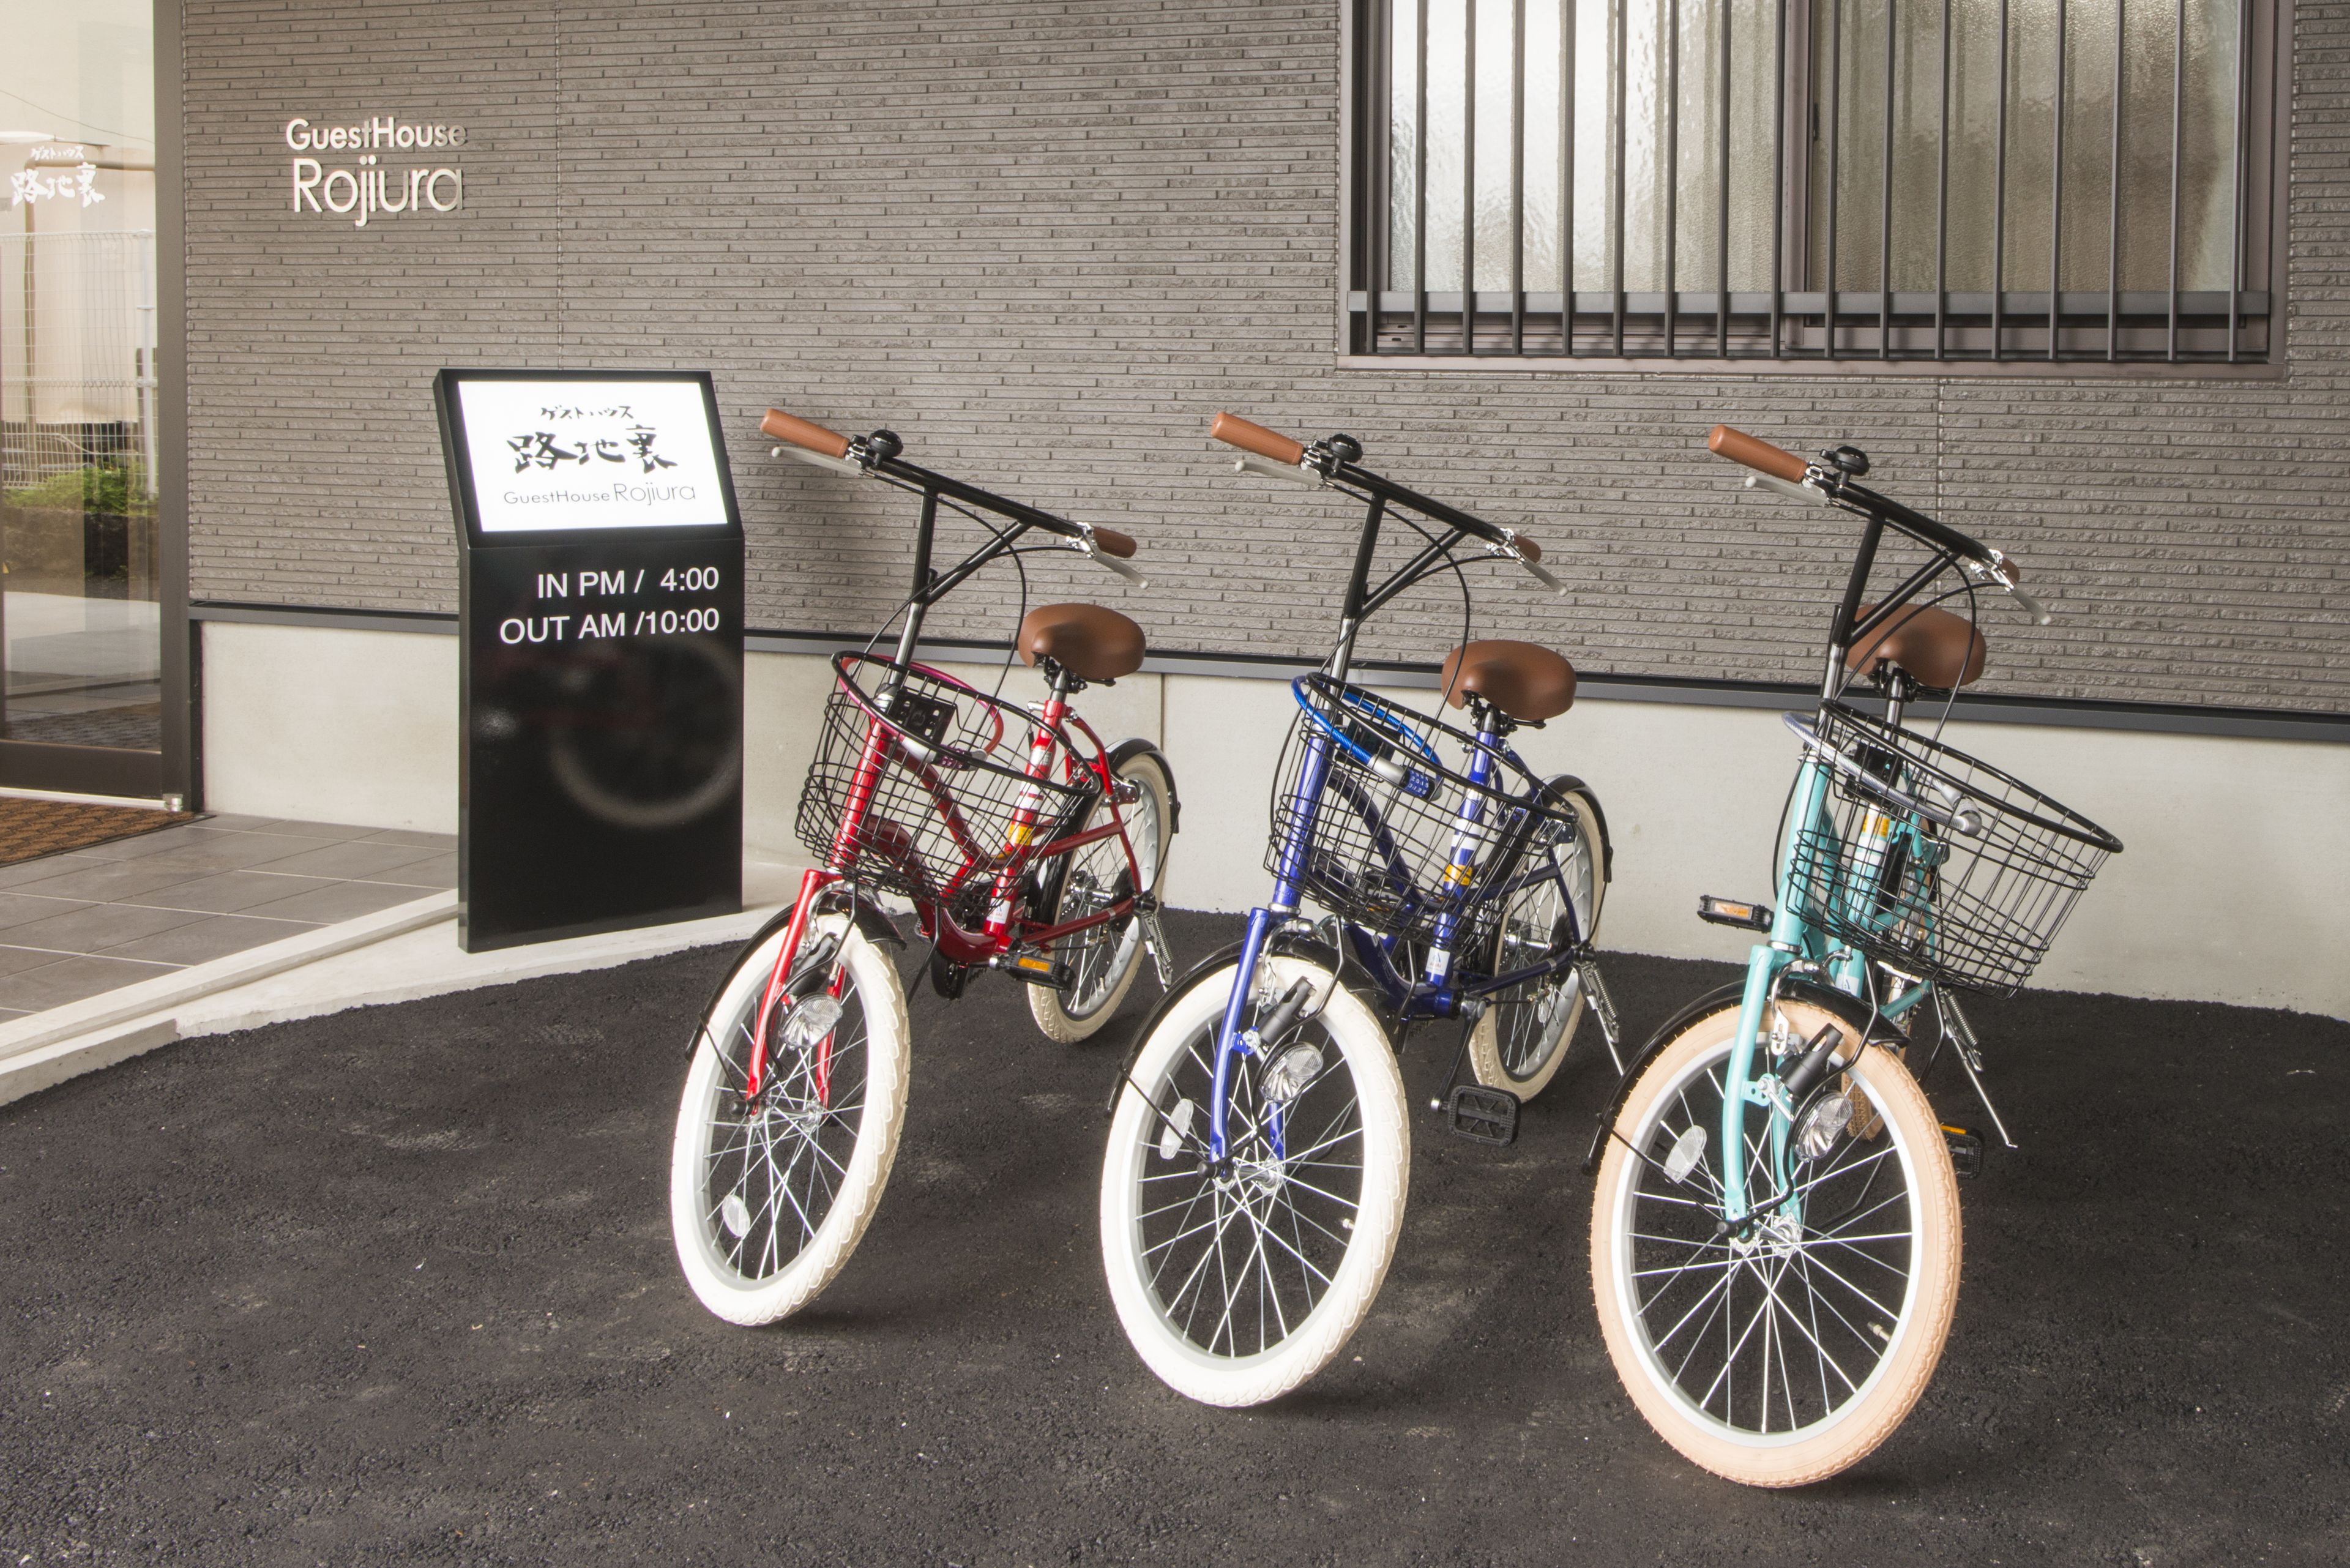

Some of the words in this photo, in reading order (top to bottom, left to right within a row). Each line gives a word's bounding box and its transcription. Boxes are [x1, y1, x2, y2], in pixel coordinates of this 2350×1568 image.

[286, 116, 467, 151] GuestHouse
[10, 162, 106, 208] 路地裏
[293, 155, 463, 227] Rojiura
[507, 424, 677, 474] 路地裏
[504, 490, 610, 505] GuestHouse
[614, 483, 696, 506] Rojiura
[538, 573, 568, 599] IN
[580, 570, 625, 596] PM
[660, 566, 720, 592] 4:00
[499, 616, 570, 644] OUT
[578, 612, 625, 639] AM
